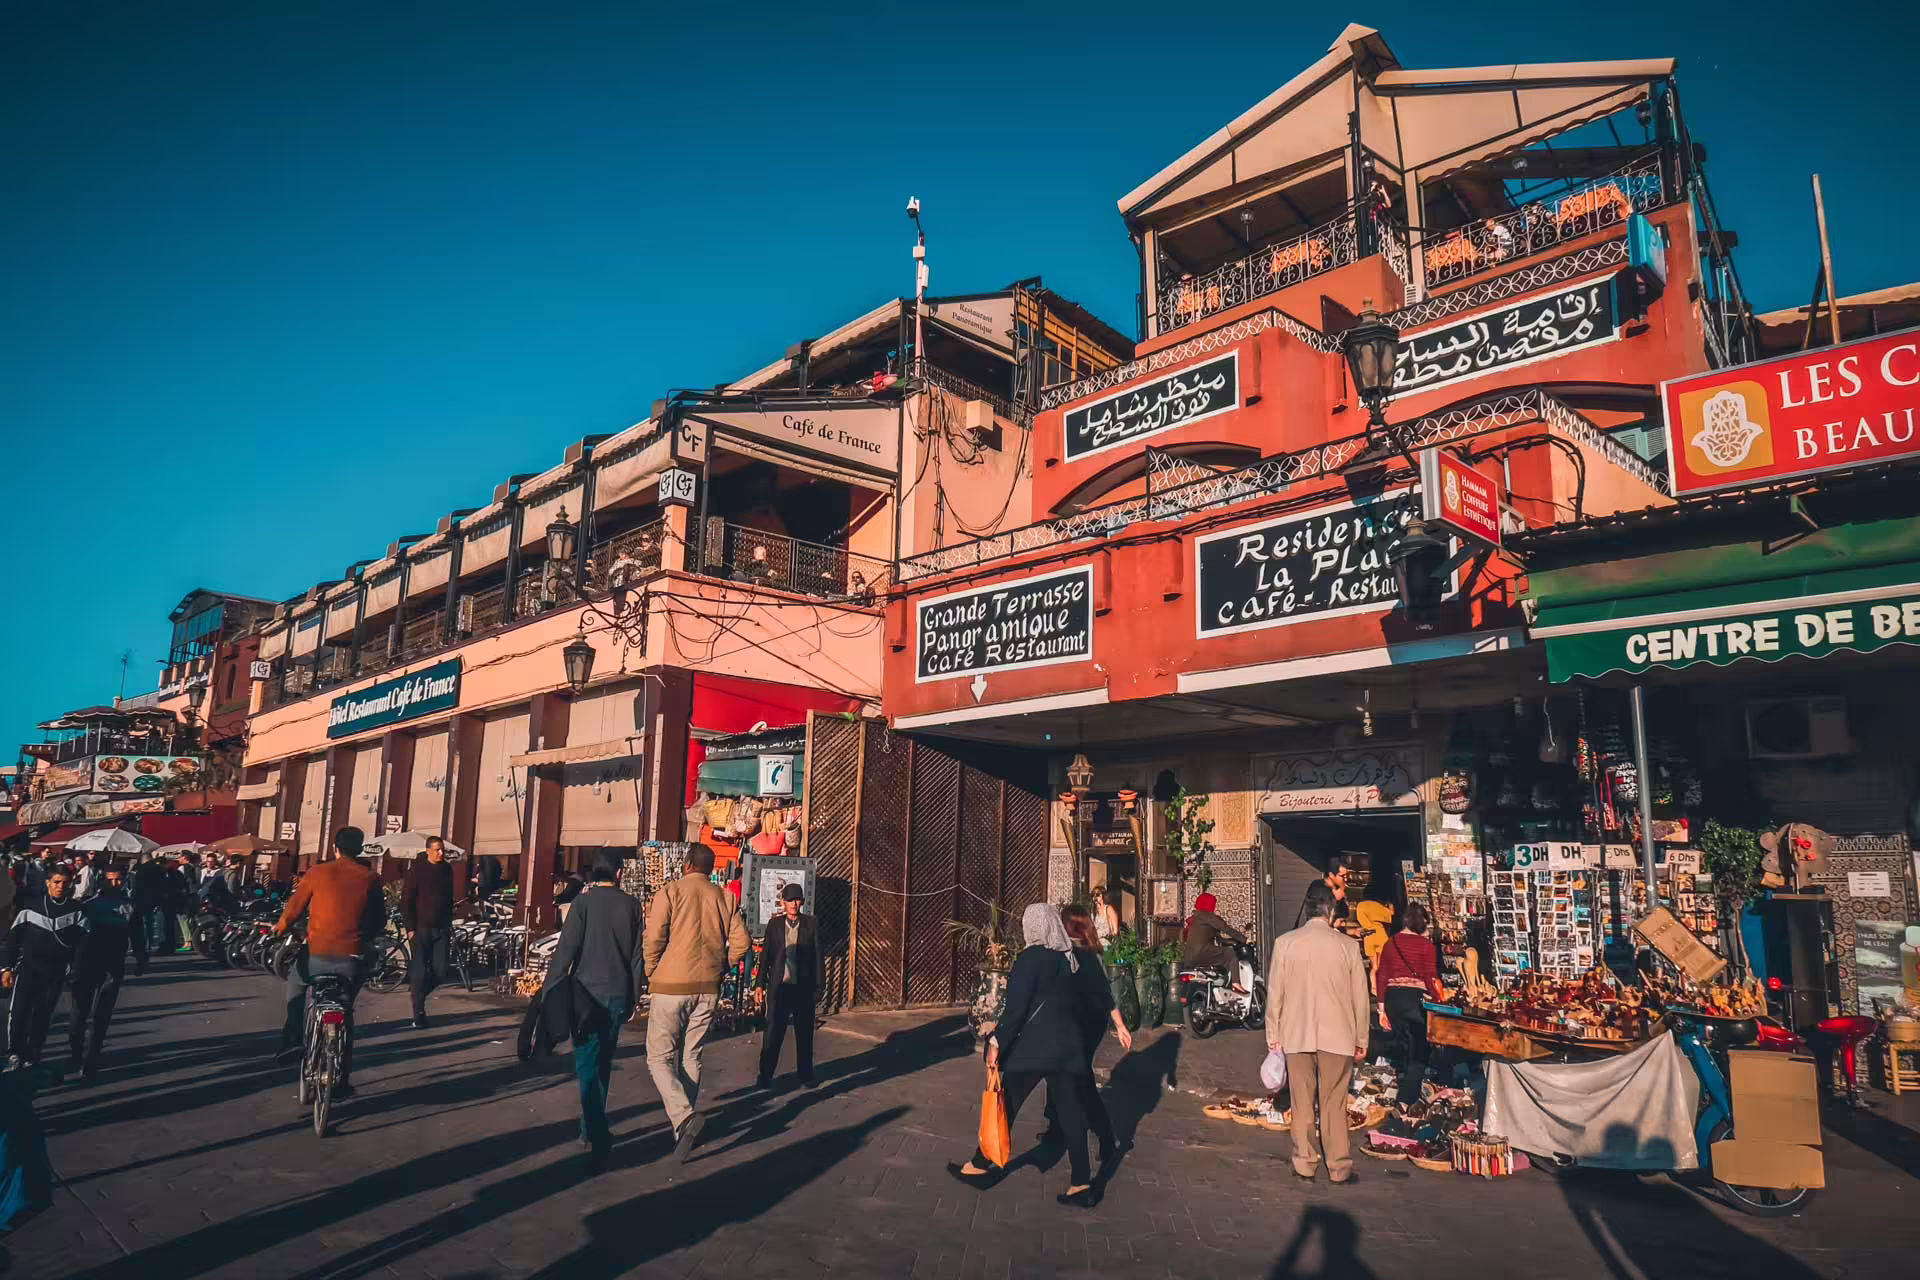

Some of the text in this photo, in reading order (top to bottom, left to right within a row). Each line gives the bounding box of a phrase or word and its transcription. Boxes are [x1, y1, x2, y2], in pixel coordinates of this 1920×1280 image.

[952, 312, 992, 334] Panoramique
[960, 303, 992, 323] Restaurant
[1396, 288, 1603, 366] إقامة الساح
[1393, 353, 1471, 388] مطع
[1776, 344, 1920, 410] LES C
[1080, 373, 1225, 434] منظر شامل
[1172, 392, 1210, 420] فوق
[783, 415, 881, 453] Café de France
[1793, 408, 1915, 459] BEAU
[1256, 563, 1292, 591] La
[924, 581, 1084, 630] Grande Terrasse
[985, 630, 1086, 664] Restaurant
[1626, 601, 1920, 664] CENTRE DE BE
[348, 691, 392, 722] Restaurant
[391, 679, 412, 716] Café
[411, 677, 422, 703] de
[422, 675, 456, 700] France
[1280, 793, 1334, 810] Bijouterie
[1516, 845, 1549, 867] 3 DH
[1562, 846, 1582, 859] DH
[1613, 847, 1630, 857] Dhs
[1669, 852, 1695, 862] 6 Dhs
